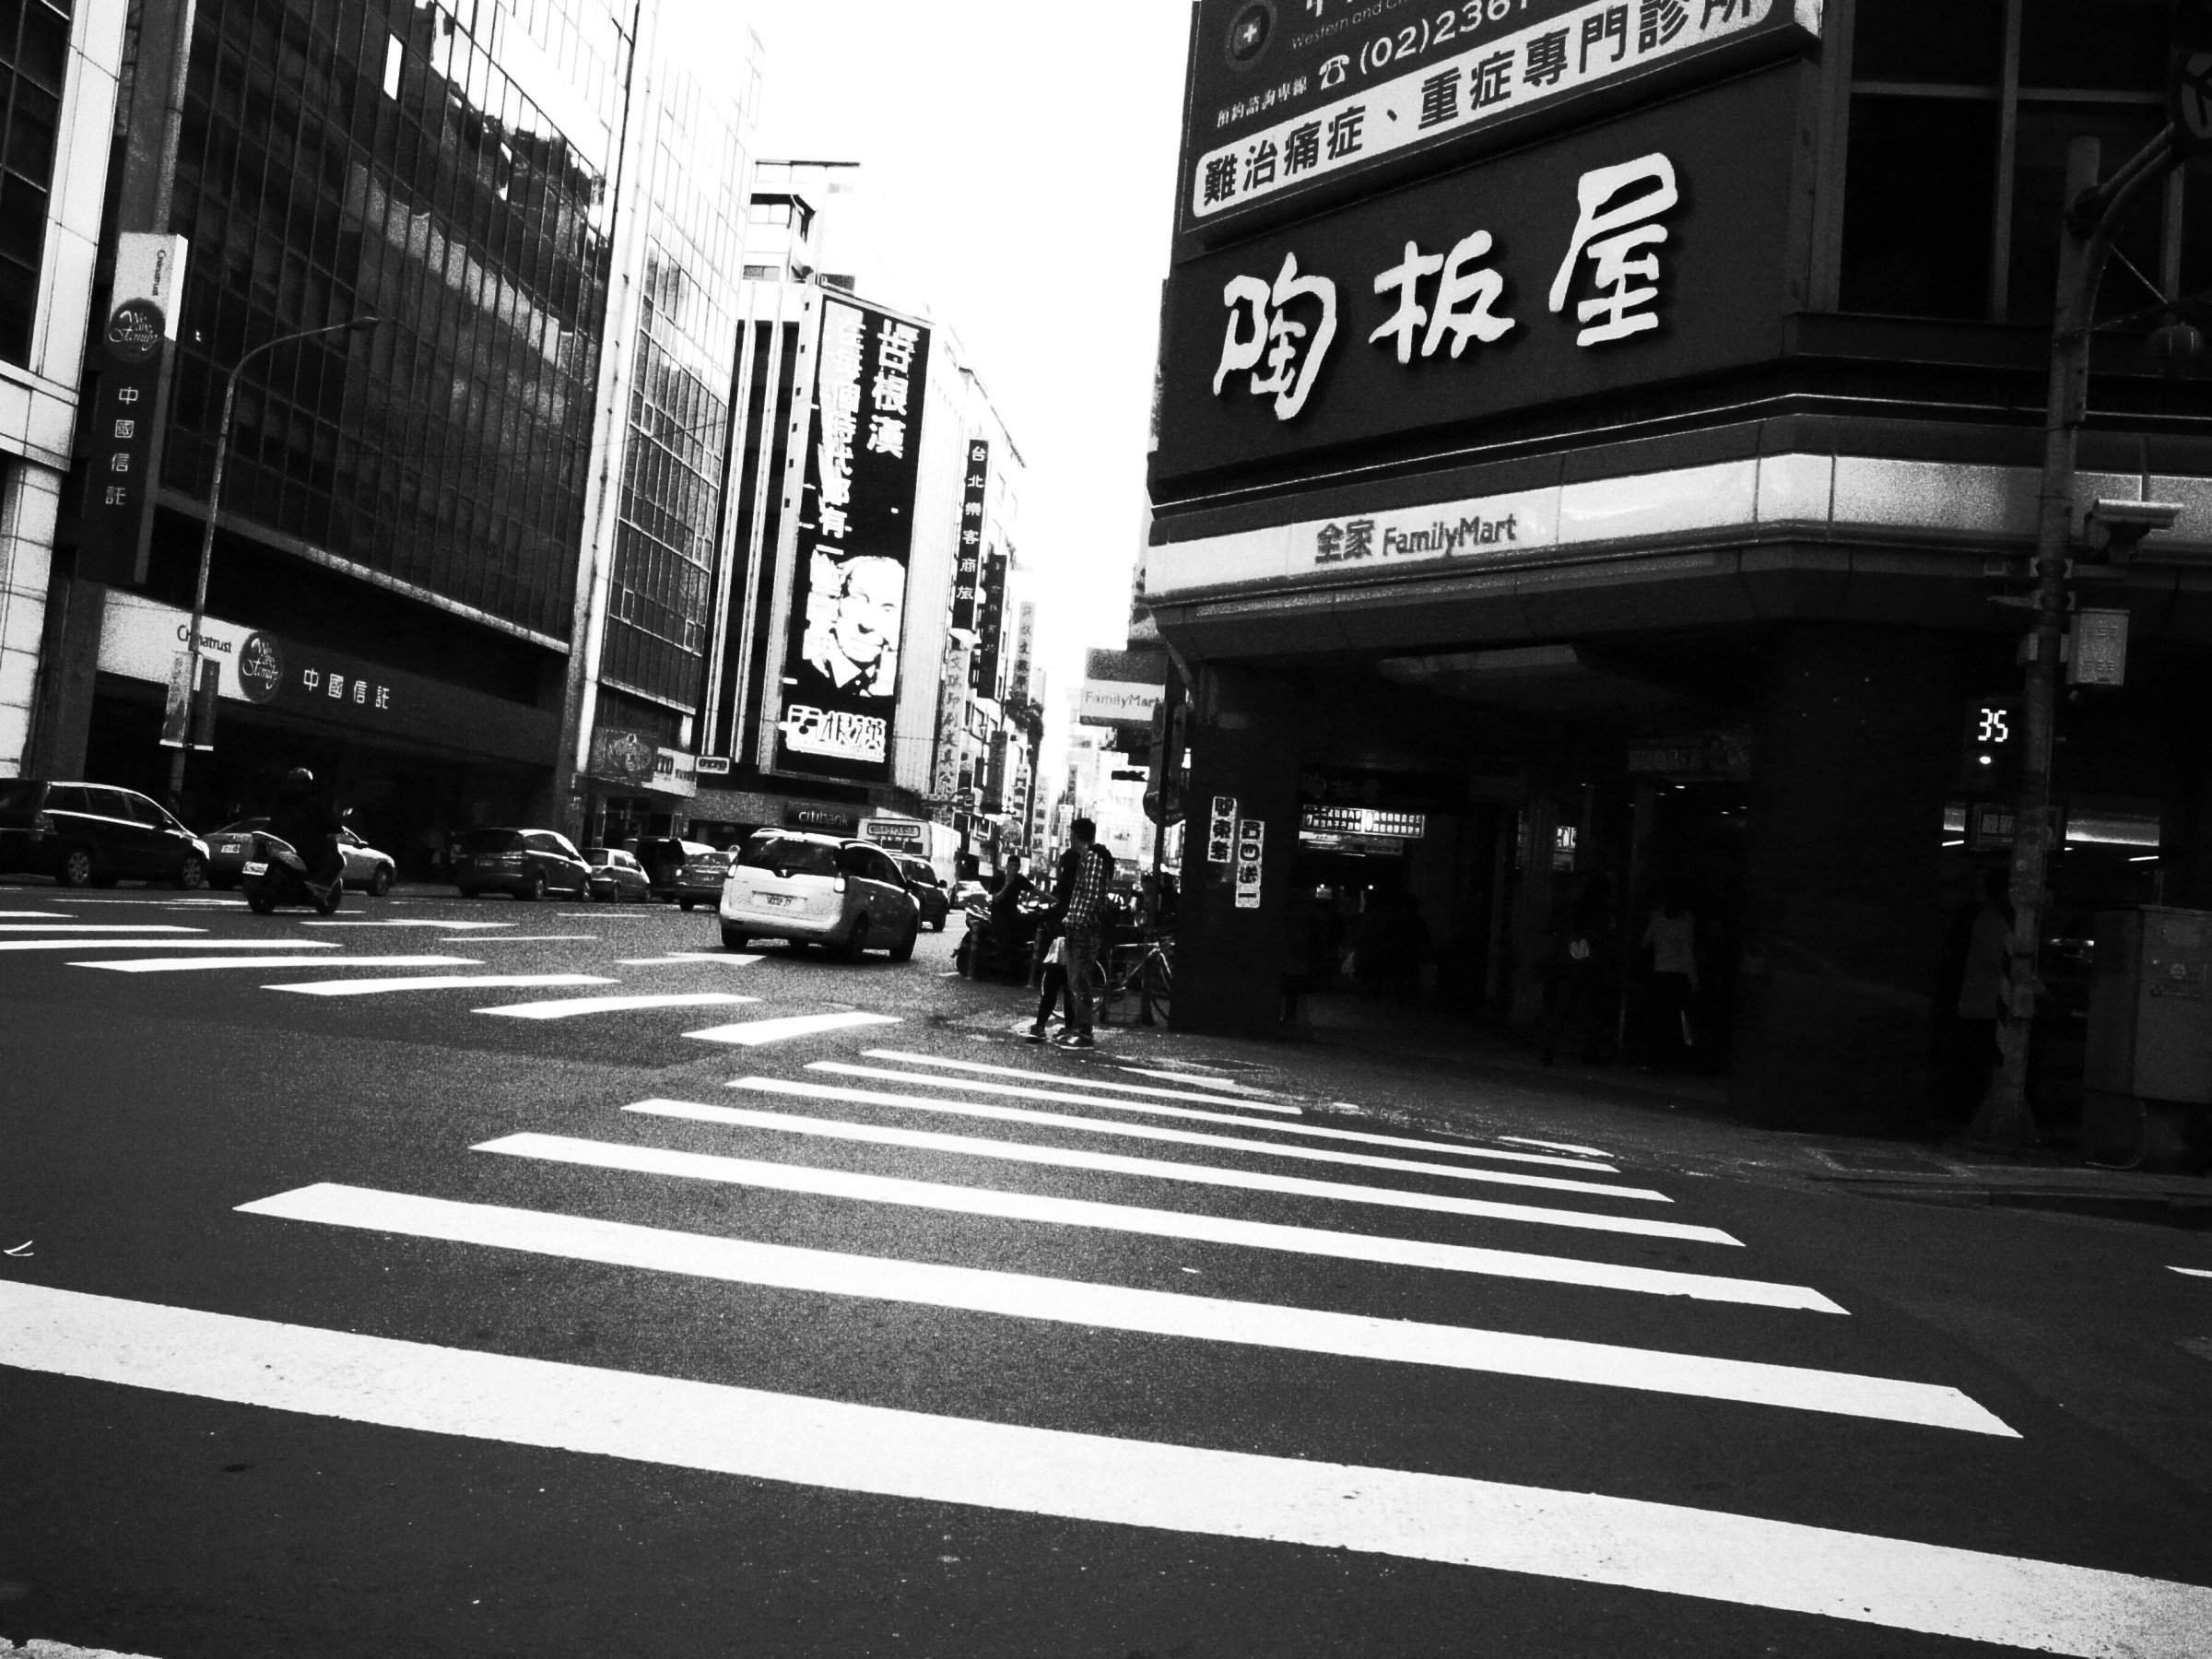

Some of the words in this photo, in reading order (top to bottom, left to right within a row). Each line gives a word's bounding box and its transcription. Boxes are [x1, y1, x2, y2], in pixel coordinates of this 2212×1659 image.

[1213, 152, 1677, 421] 陶板屋
[105, 385, 139, 506] 中國信託
[1314, 519, 1375, 565] 全家
[1382, 512, 1518, 558] FamilyMart
[302, 667, 391, 710] 中國信託
[1978, 707, 2008, 743] 35
[798, 809, 849, 827] citibank
